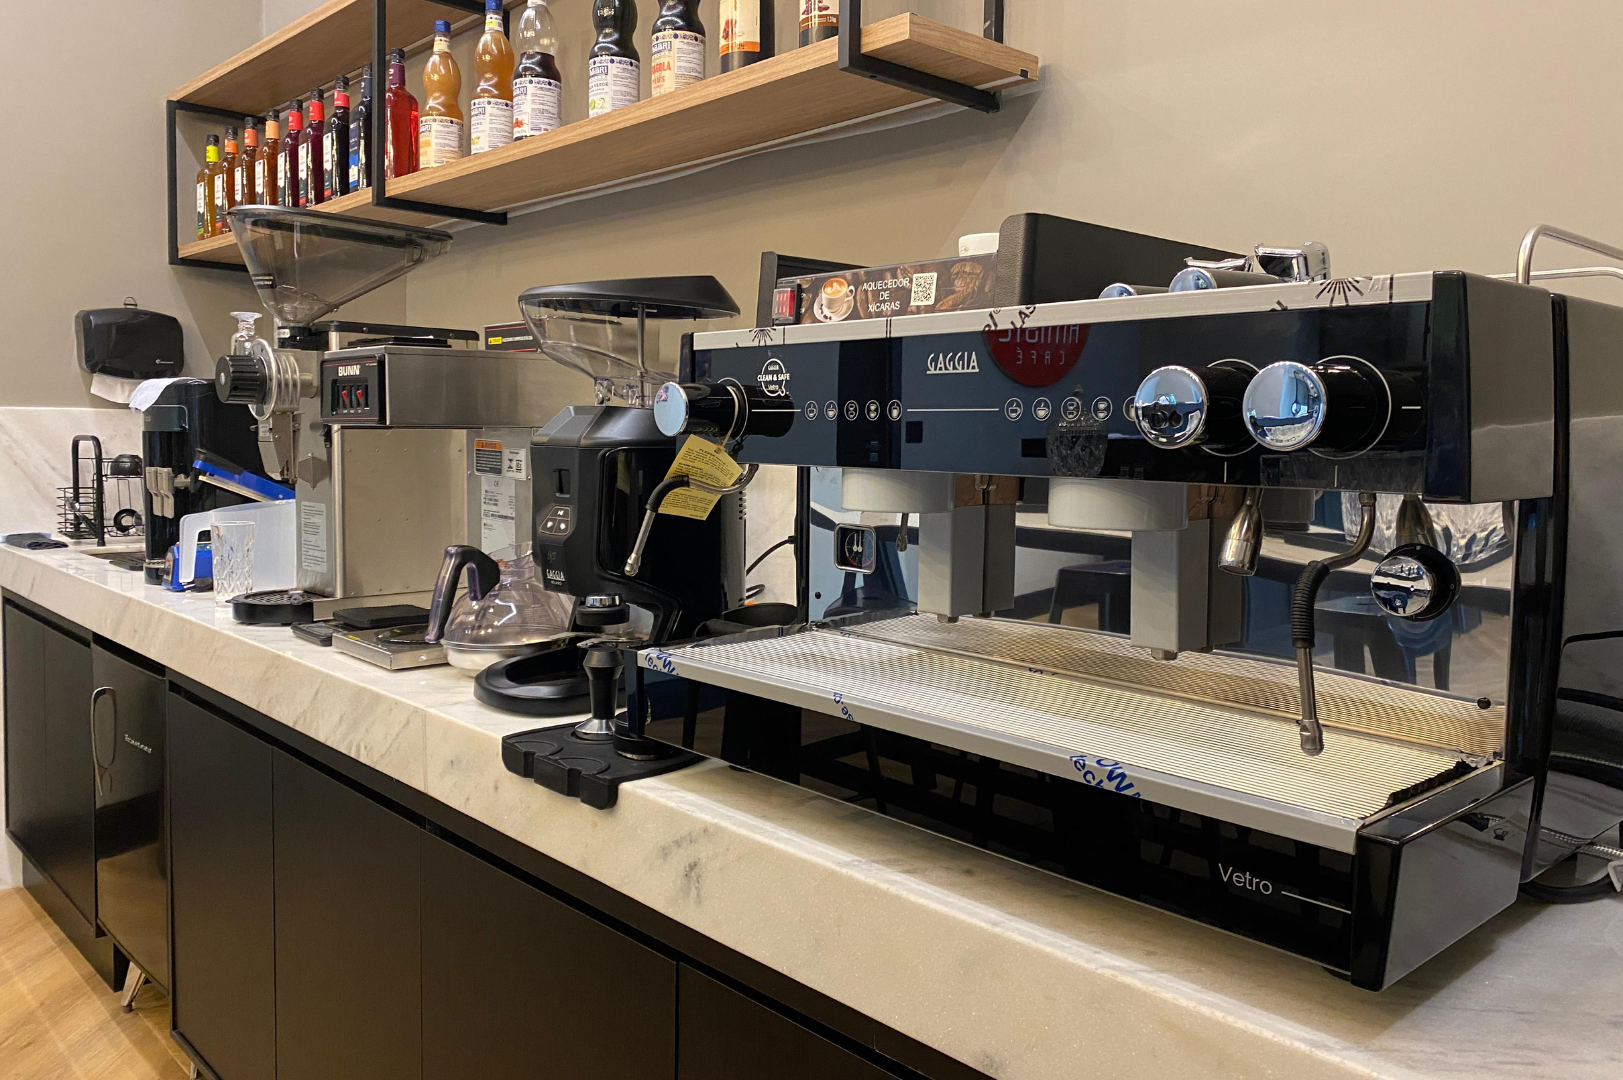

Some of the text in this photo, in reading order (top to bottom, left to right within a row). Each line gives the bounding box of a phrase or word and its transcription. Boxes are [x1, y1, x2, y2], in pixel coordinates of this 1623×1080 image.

[862, 278, 910, 291] AQUECEDOR
[879, 291, 890, 301] DE
[868, 301, 901, 312] XÍCARAS
[927, 351, 979, 373] GAGGIA
[338, 365, 360, 377] BUNN
[757, 374, 773, 382] CLEAN
[778, 373, 790, 381] SAFE
[546, 569, 566, 581] GAGGIA
[1218, 863, 1273, 895] Vetro
